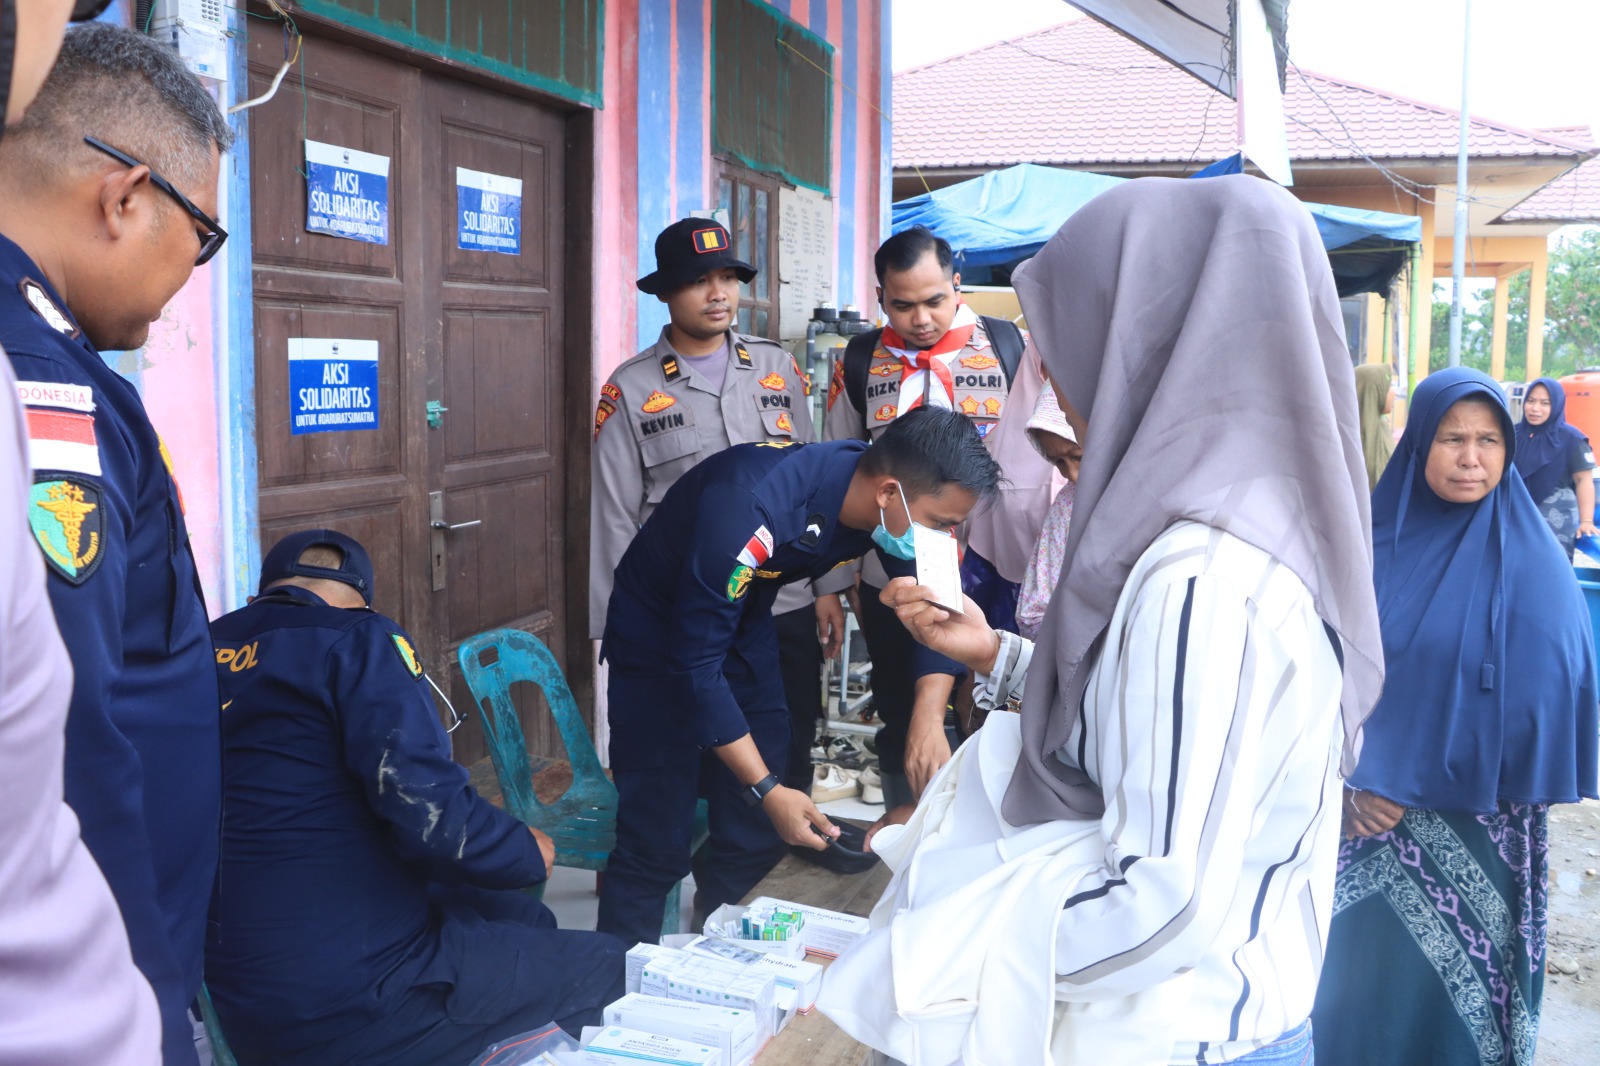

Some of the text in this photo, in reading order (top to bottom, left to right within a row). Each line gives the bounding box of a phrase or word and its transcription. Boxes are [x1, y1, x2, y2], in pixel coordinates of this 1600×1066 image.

[334, 170, 359, 195] AKSI
[311, 190, 380, 222] SOLIDARITAS
[480, 192, 499, 213] AKSI
[309, 215, 329, 229] UNTUK
[463, 210, 515, 236] SOLIDARITAS
[322, 362, 349, 385] AKSI
[955, 374, 1001, 388] POLRI
[18, 386, 88, 406] DONESIA
[299, 386, 371, 411] SOLIDARITAS
[867, 380, 901, 399] RIZK
[296, 411, 375, 427] UNTUK #DARURATSUMATRA
[640, 412, 684, 436] KEVIN
